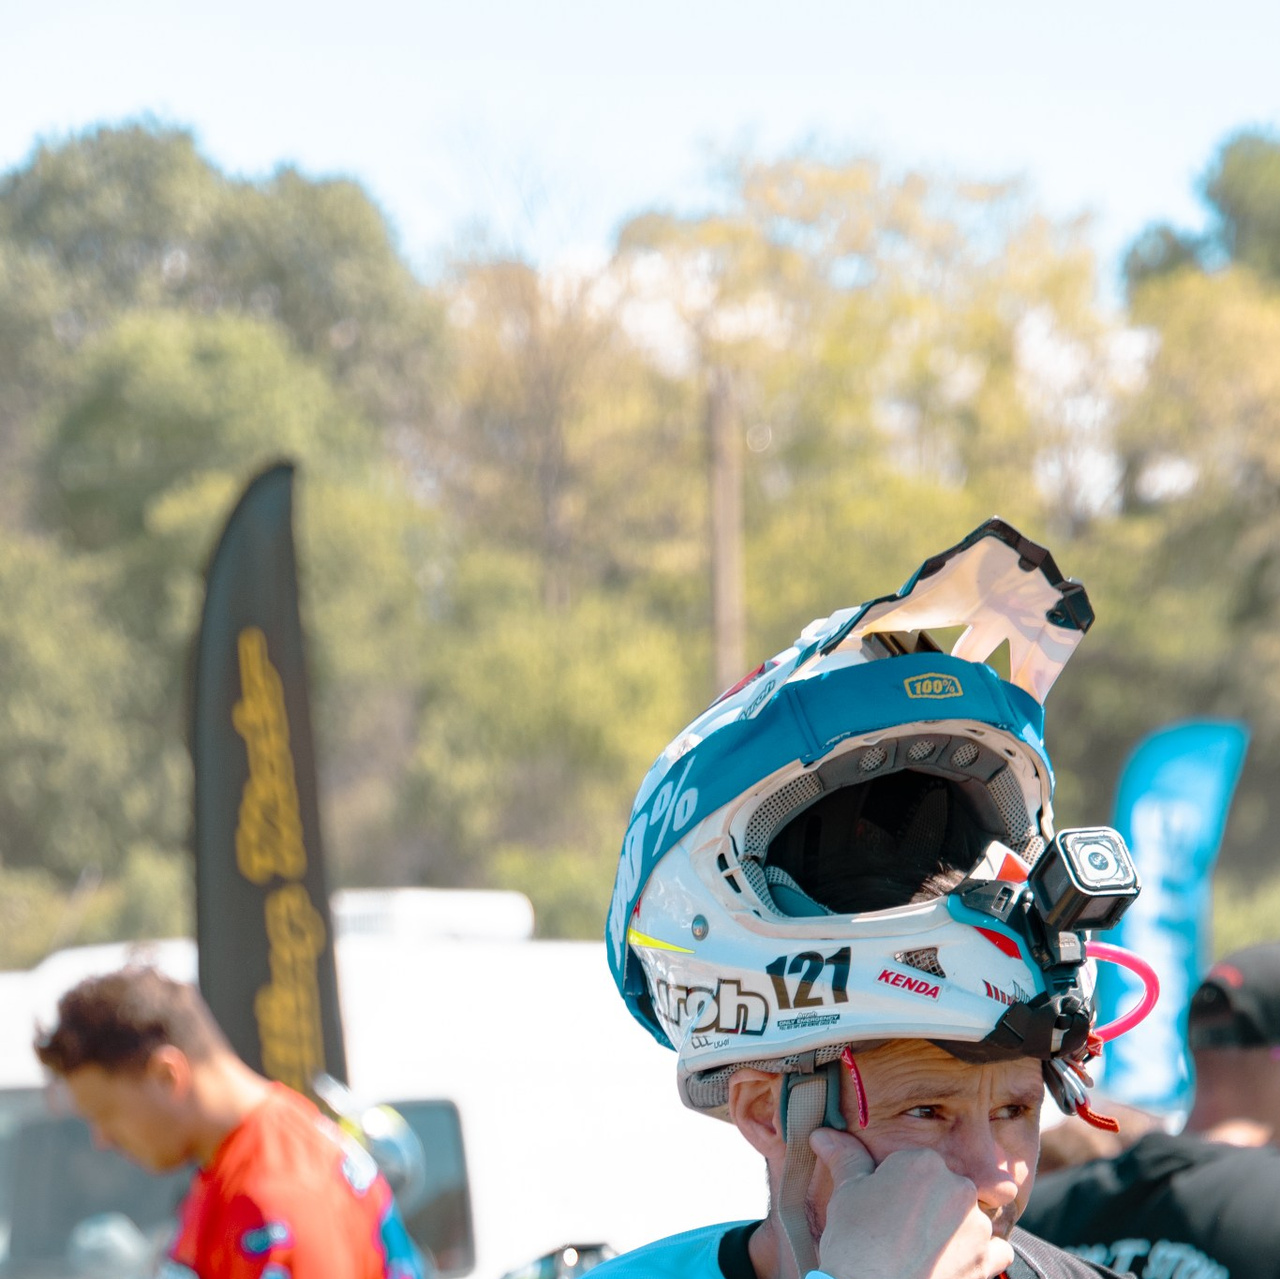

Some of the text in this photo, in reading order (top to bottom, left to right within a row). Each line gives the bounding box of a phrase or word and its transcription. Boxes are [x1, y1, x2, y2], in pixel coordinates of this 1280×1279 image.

[912, 677, 956, 697] 100%
[766, 946, 852, 1010] 121
[877, 969, 942, 1000] KENDA
